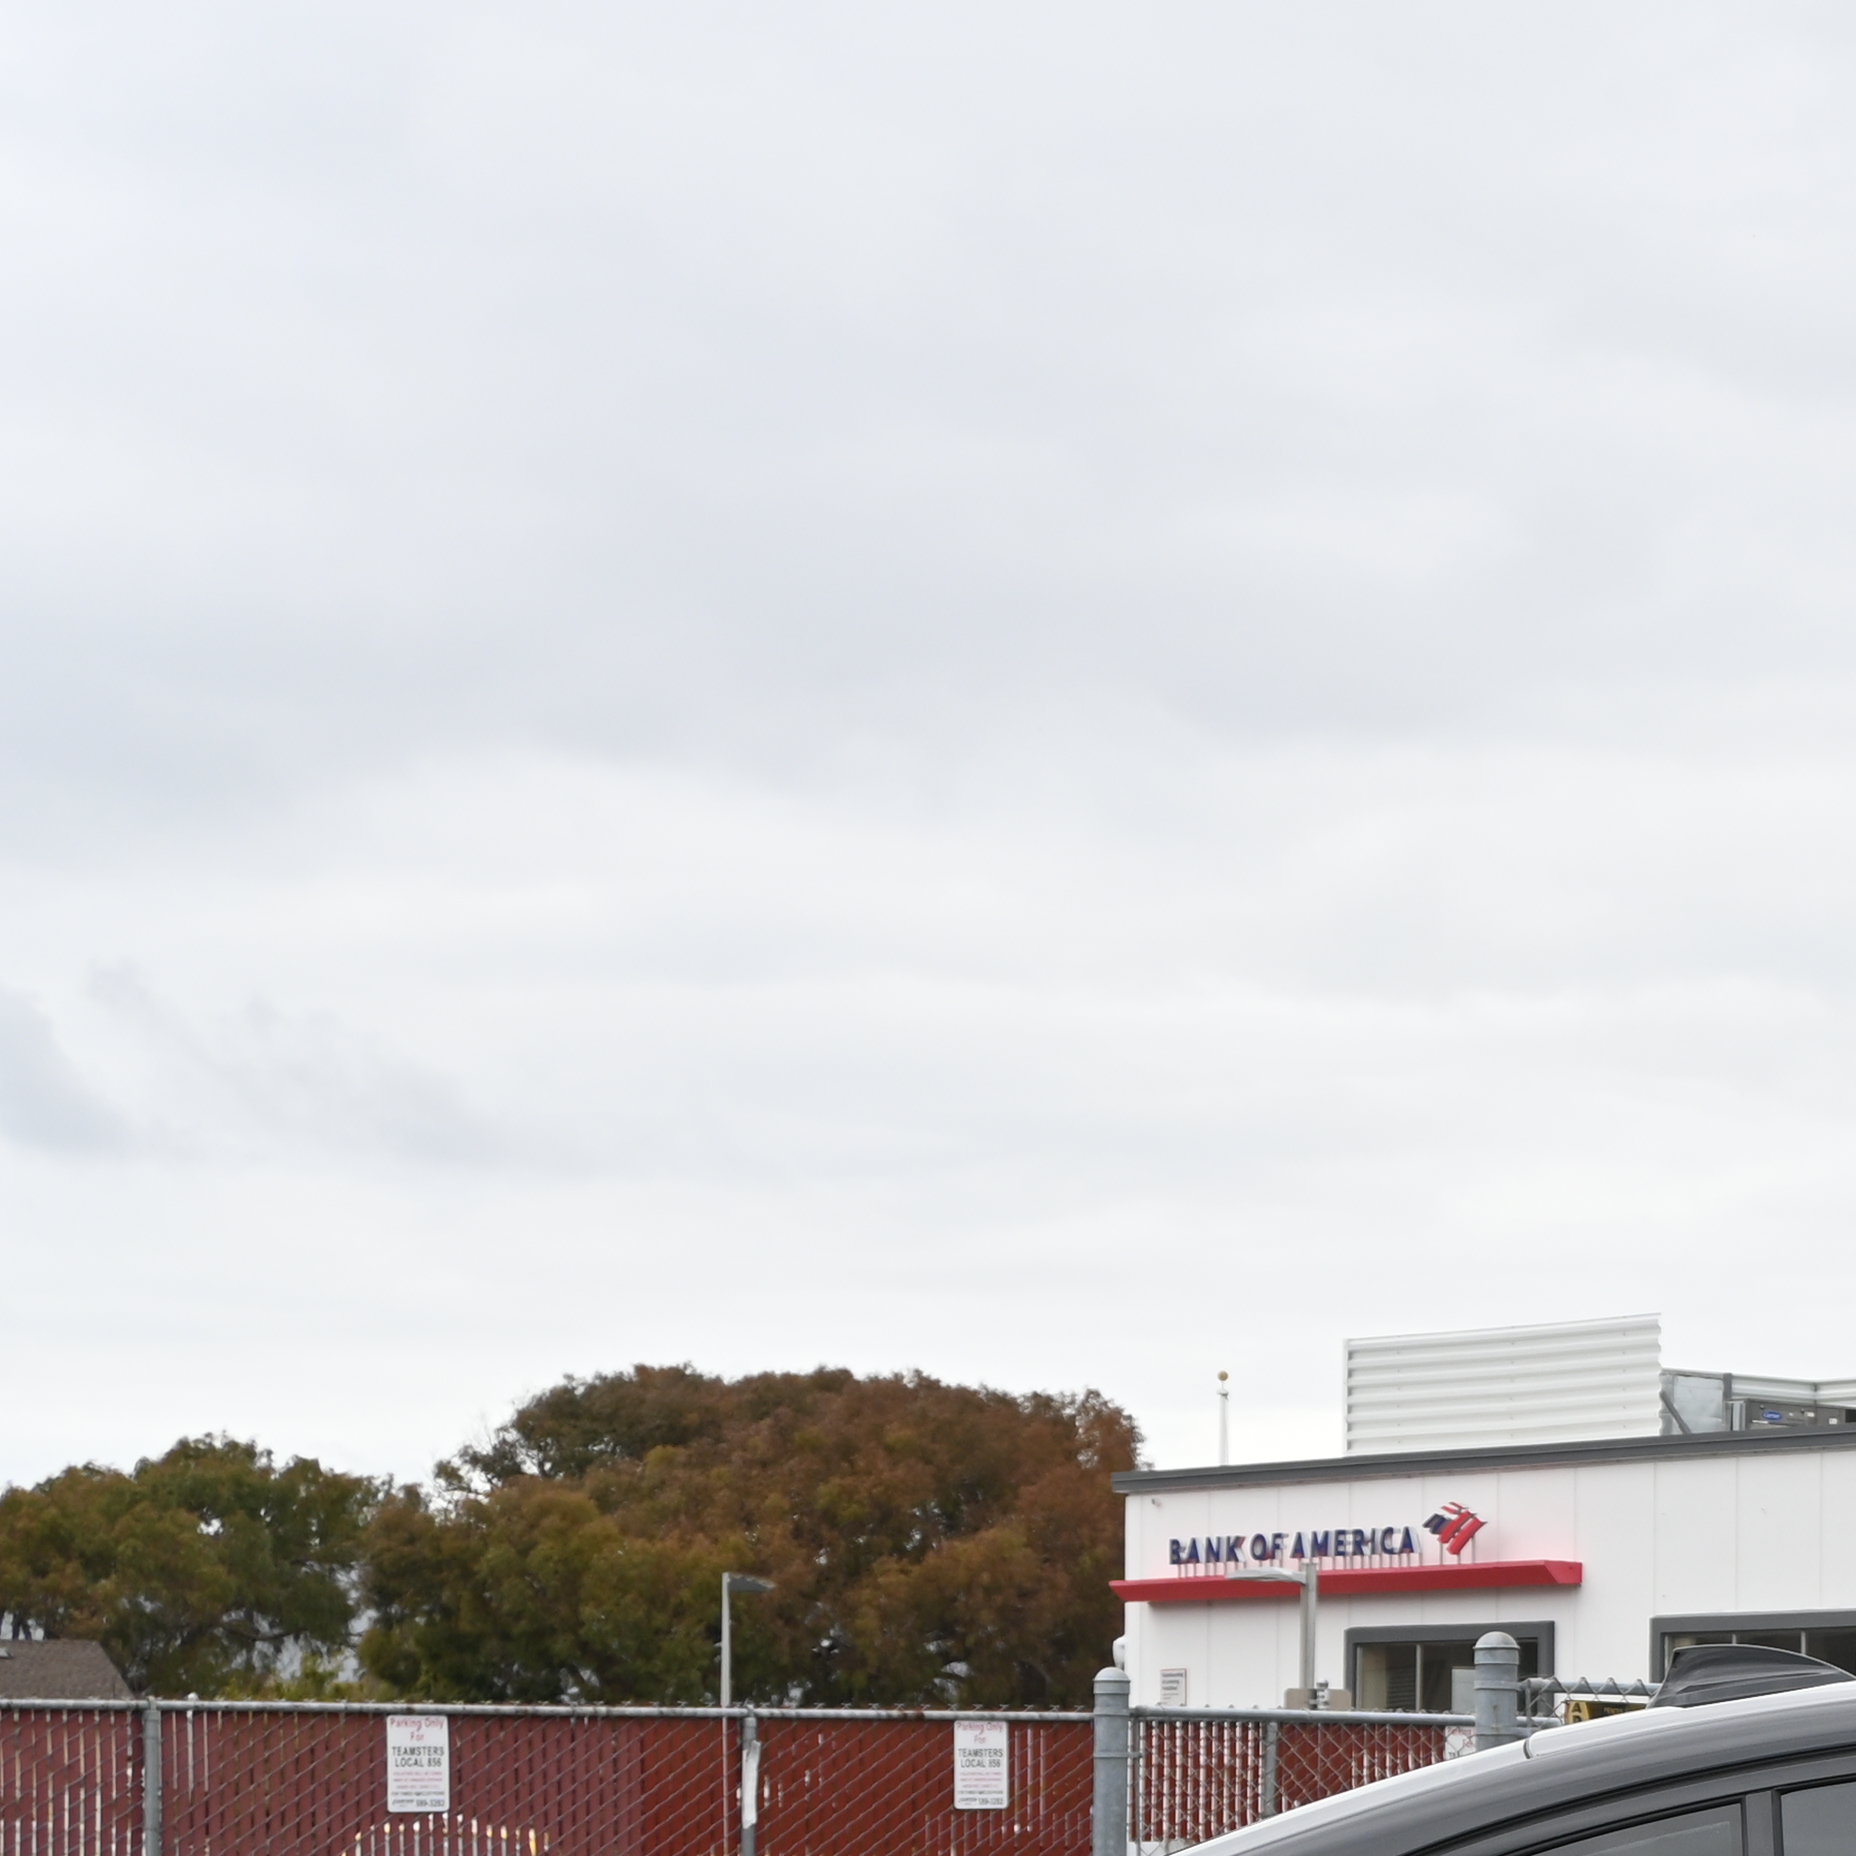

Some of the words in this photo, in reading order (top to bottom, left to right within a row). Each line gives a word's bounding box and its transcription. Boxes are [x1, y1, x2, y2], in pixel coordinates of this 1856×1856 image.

[1169, 1536, 1246, 1565] BANK
[1250, 1532, 1288, 1560] OF
[1290, 1526, 1417, 1559] AMERICA
[390, 1717, 422, 1731] Parking
[424, 1717, 445, 1729] Only
[956, 1722, 985, 1735] Parking
[986, 1721, 1004, 1733] Only
[410, 1731, 425, 1741] For
[974, 1734, 986, 1744] For
[392, 1746, 445, 1757] TEAMSTERS
[958, 1748, 1004, 1758] TEAMSTERS
[395, 1757, 424, 1767] LOCAL
[960, 1758, 986, 1768] LOCAL
